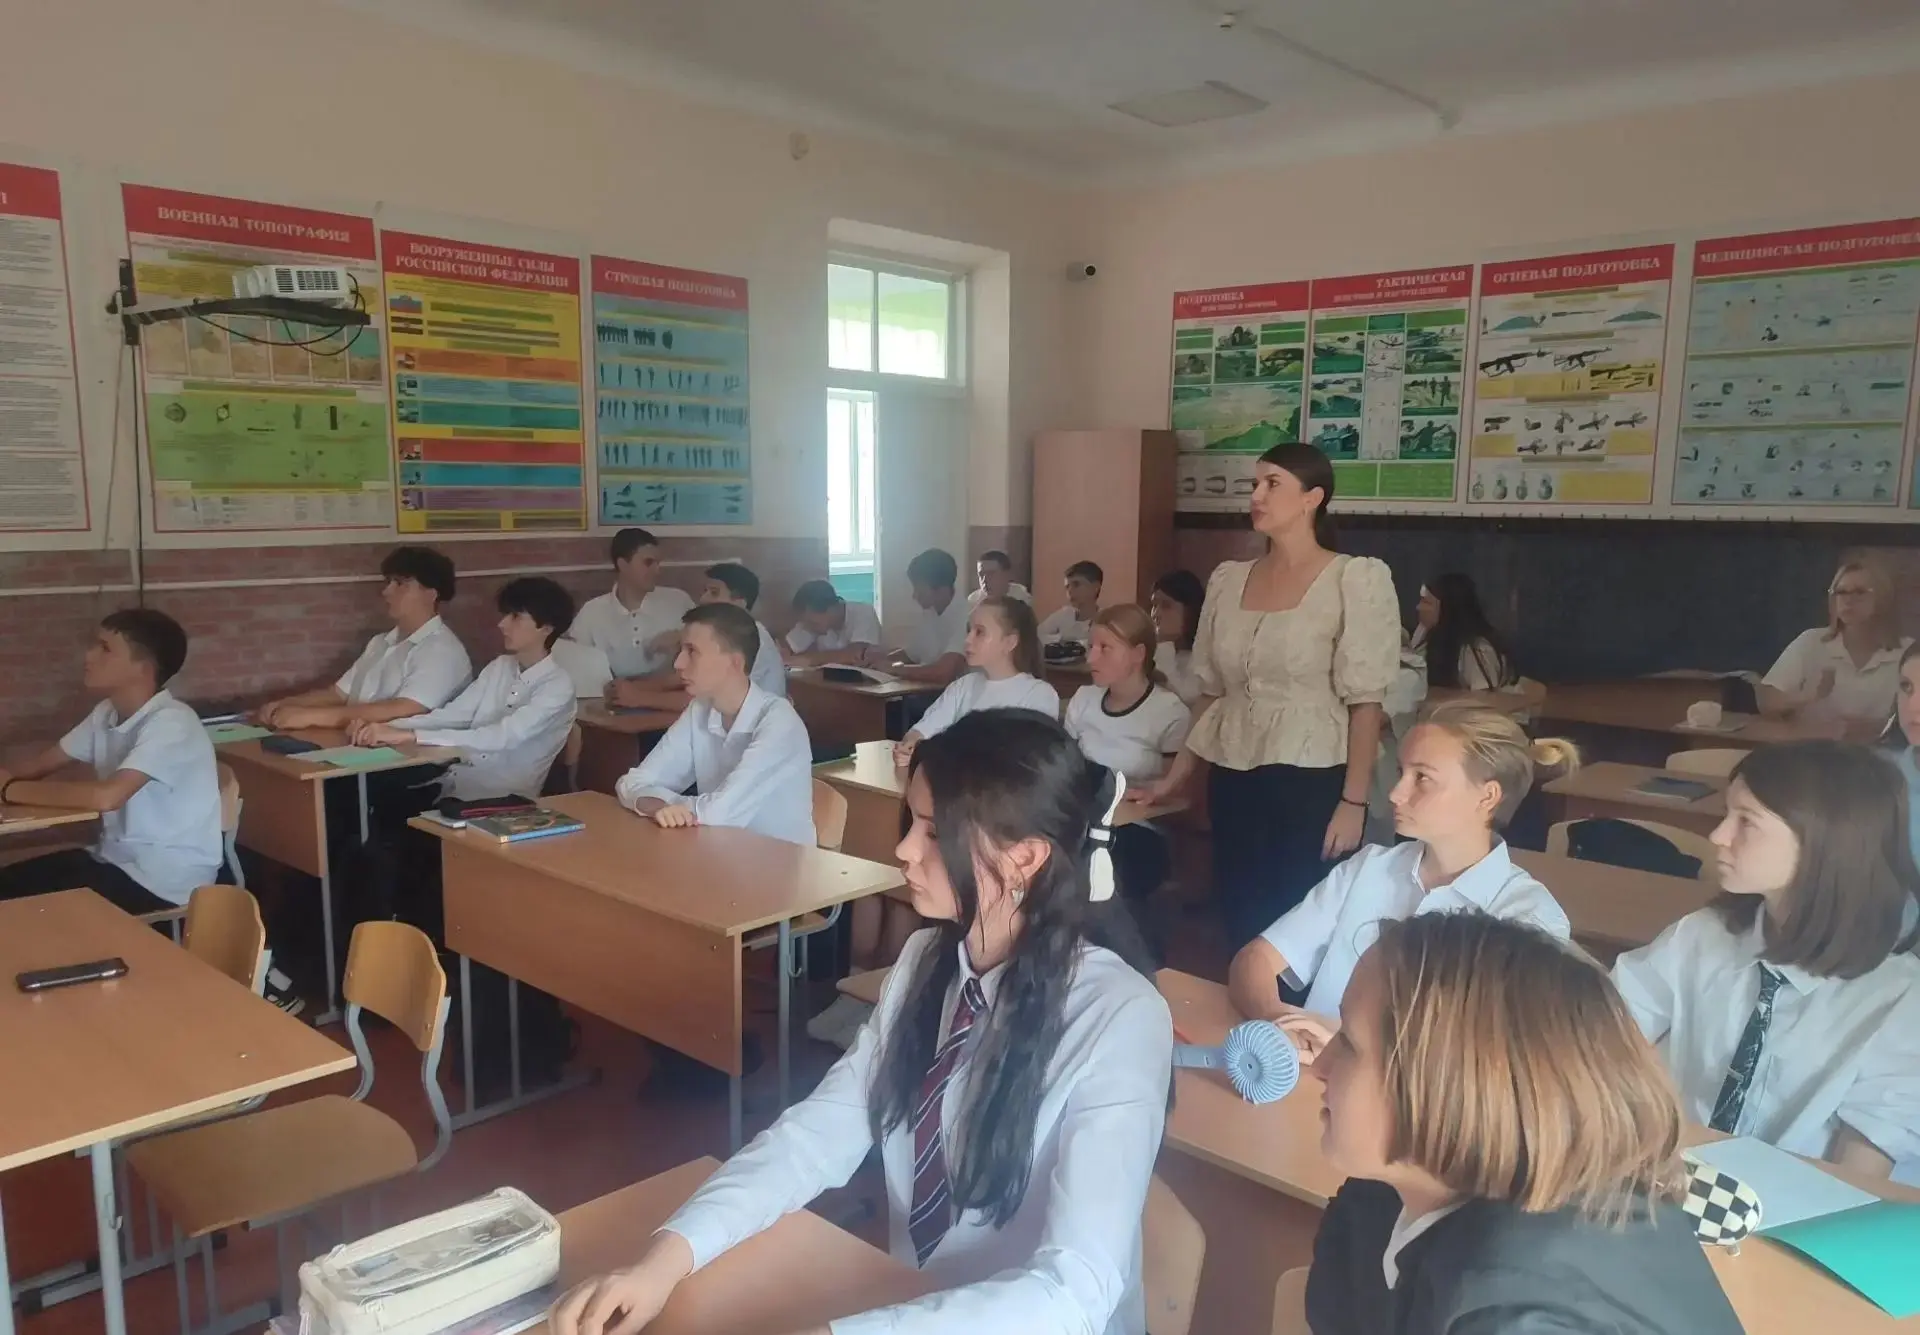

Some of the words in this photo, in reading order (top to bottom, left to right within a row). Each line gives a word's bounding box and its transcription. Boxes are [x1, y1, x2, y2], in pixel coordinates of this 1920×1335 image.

[158, 206, 239, 229] ВОЕННАЯ
[244, 218, 350, 242] ТОПОГРАФИЯ
[1493, 267, 1558, 283] ОГНЕВАЯ
[1562, 257, 1661, 278] ПОДГОТОВКА
